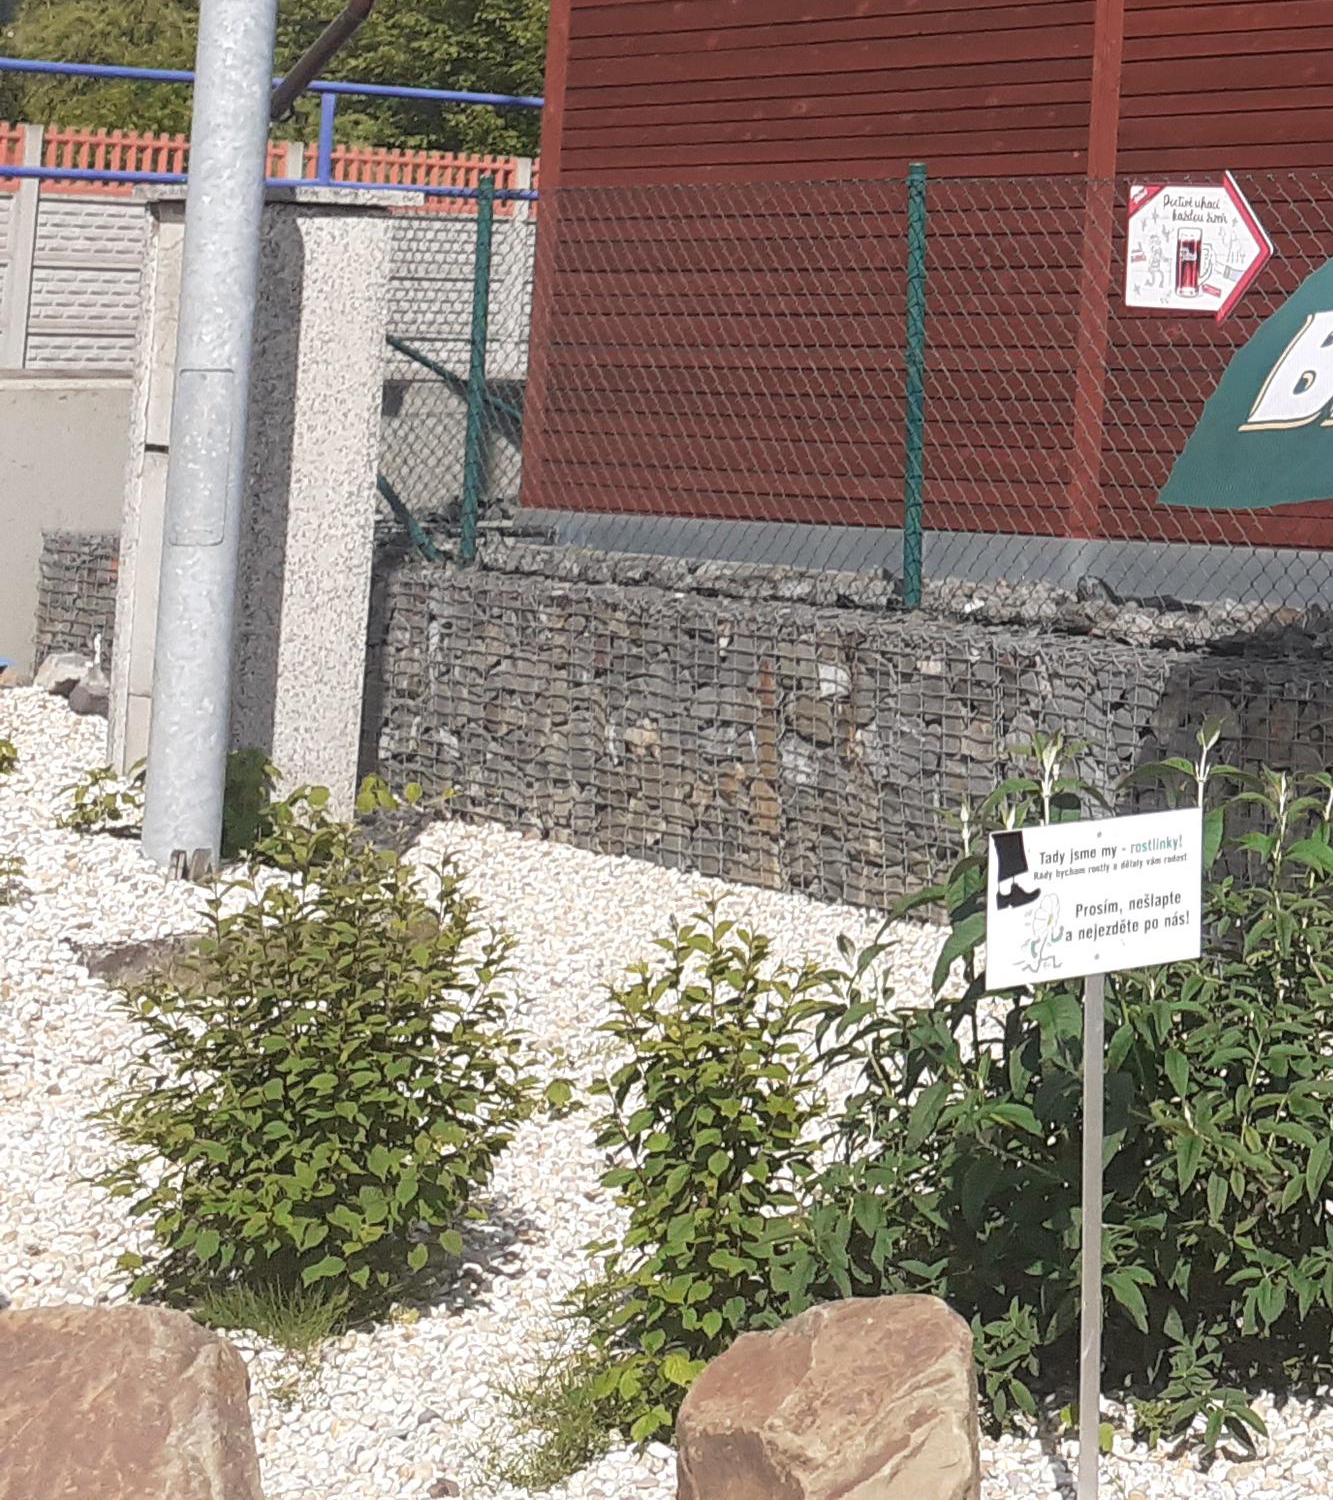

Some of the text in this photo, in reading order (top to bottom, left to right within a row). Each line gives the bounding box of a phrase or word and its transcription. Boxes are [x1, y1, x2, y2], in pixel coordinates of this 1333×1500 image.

[1040, 851, 1065, 866] Tady
[1070, 847, 1096, 864] jsme
[1101, 844, 1117, 858] my
[1130, 835, 1183, 854] rostlinky!
[1075, 891, 1181, 918] Prosím, nešlapte
[1065, 911, 1190, 941] a nejezděte po nás!
